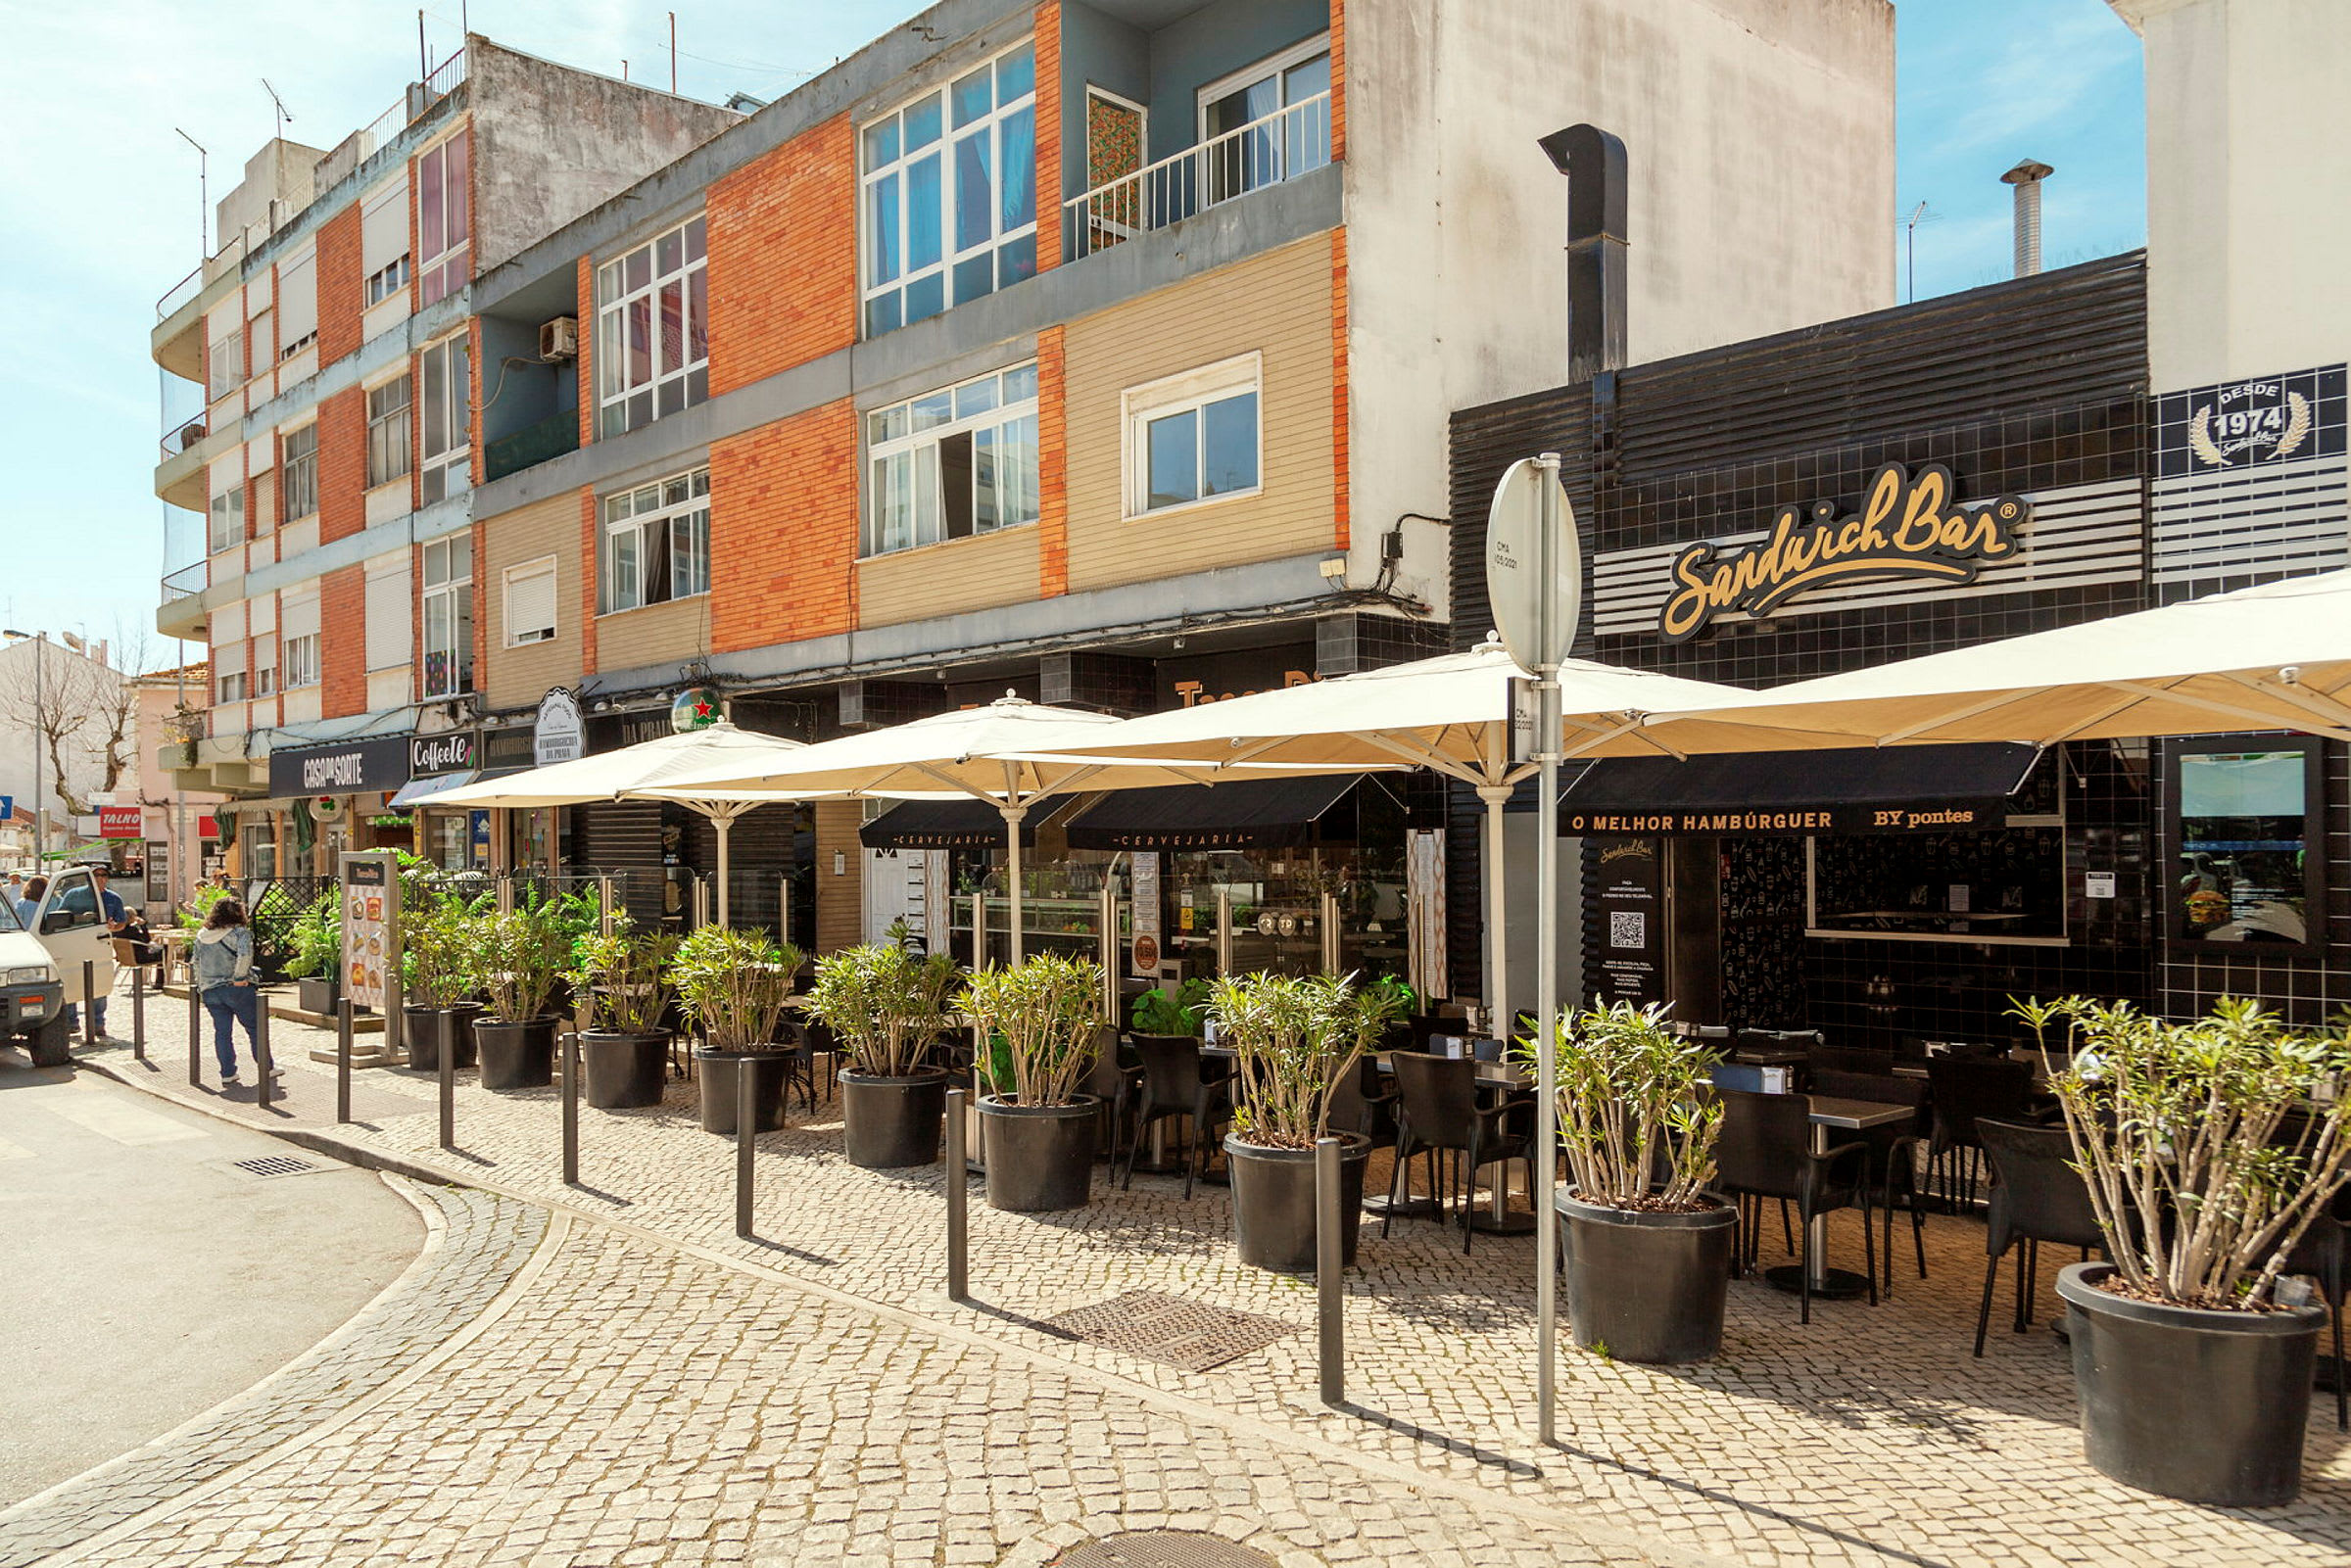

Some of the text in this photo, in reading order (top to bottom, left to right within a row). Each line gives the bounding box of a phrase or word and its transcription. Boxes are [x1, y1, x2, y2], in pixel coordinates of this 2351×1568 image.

[2220, 384, 2279, 404] DESDE
[2214, 406, 2281, 437] 1974
[1664, 468, 1889, 636] Sandwich
[304, 757, 326, 788] CASA
[334, 753, 362, 786] SORTE
[1572, 810, 1974, 831] O MELHOR HAMBÚRGUER BY pontes
